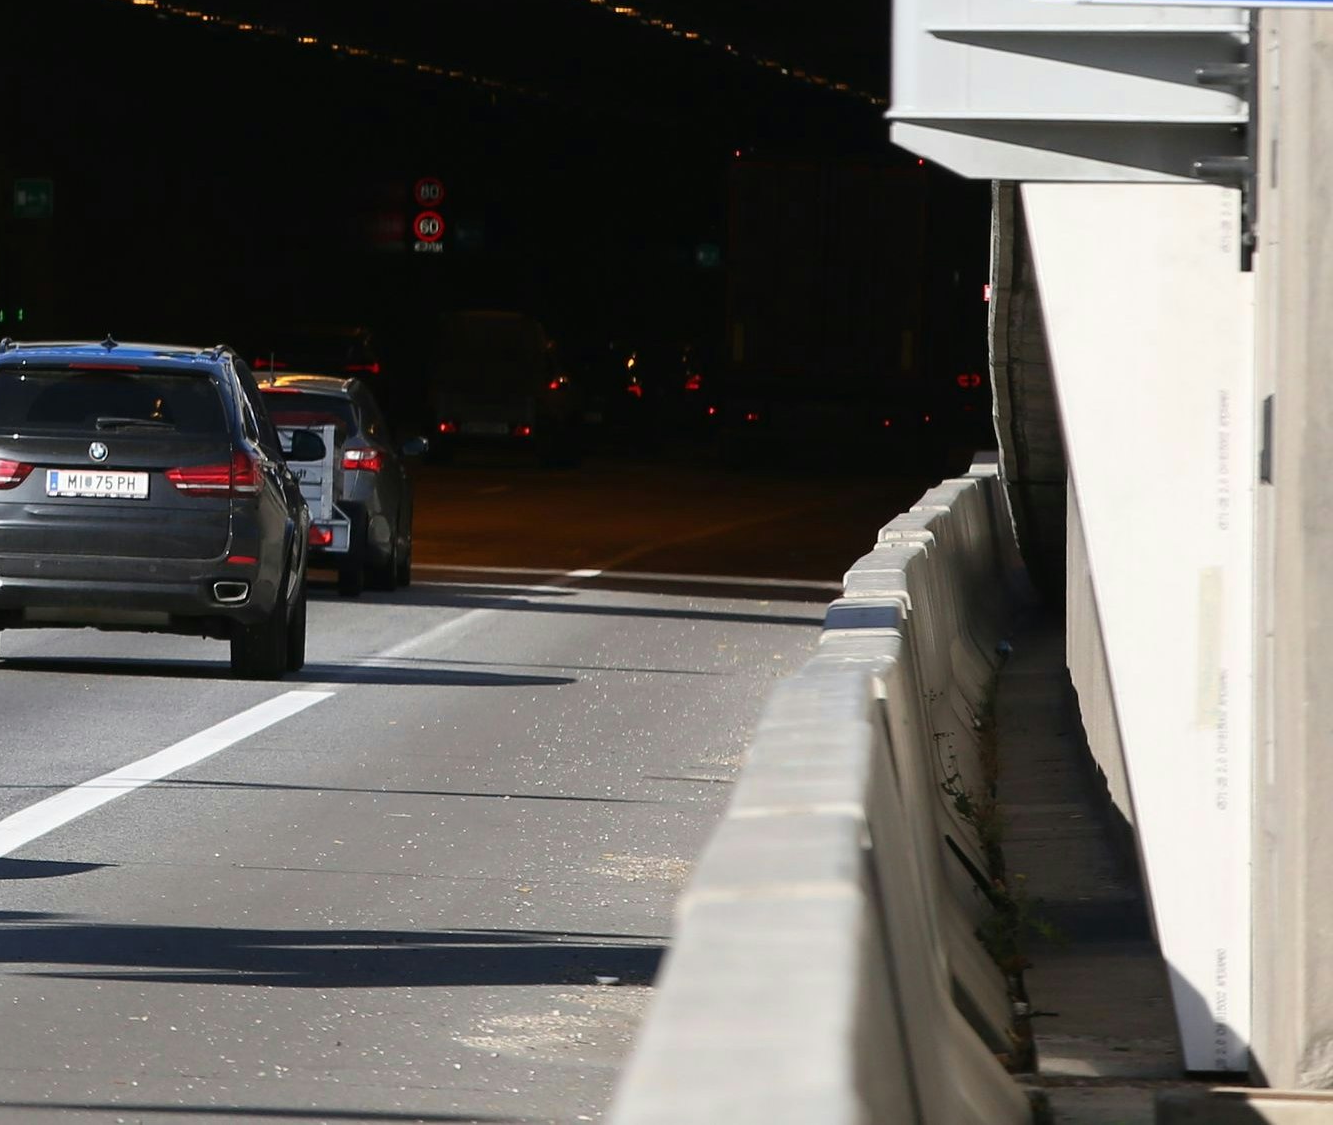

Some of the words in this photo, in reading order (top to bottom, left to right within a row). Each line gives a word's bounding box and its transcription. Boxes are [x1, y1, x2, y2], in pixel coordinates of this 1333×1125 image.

[421, 183, 439, 199] 80
[420, 218, 439, 235] 60
[96, 476, 113, 490] 75
[118, 477, 136, 491] PH
